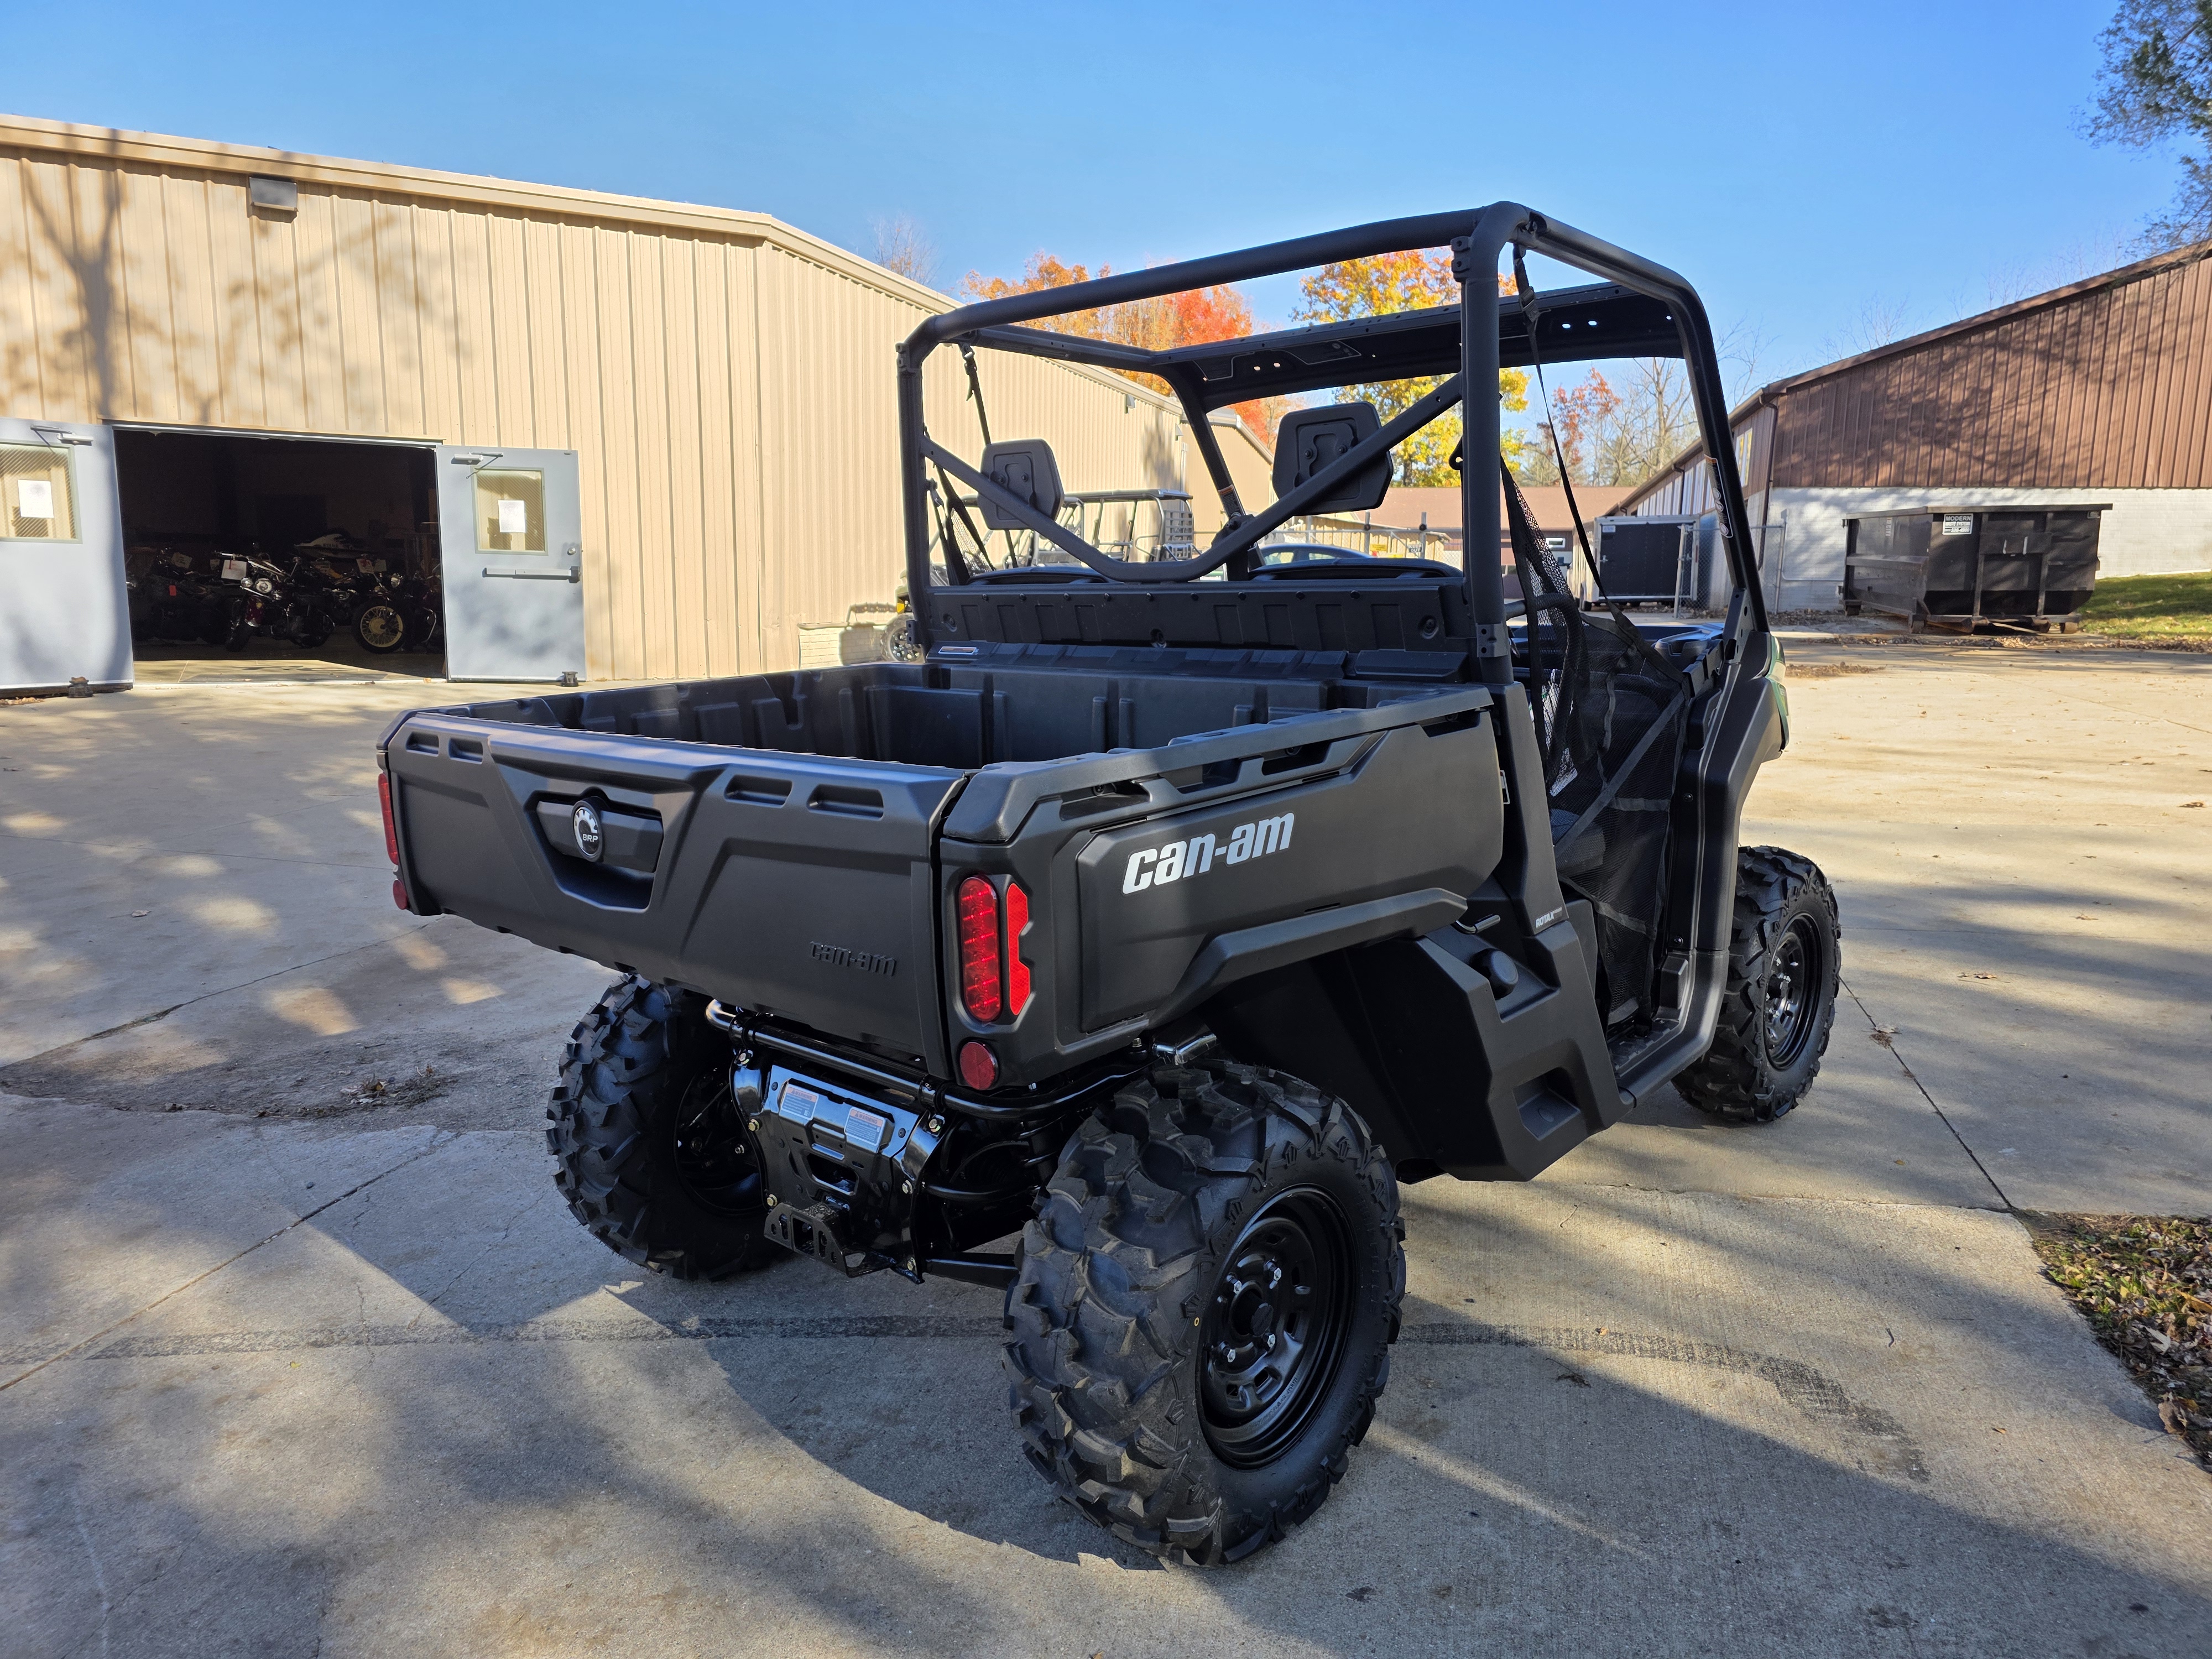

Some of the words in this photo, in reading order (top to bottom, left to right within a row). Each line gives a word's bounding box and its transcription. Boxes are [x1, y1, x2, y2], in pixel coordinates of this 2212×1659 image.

[582, 833, 598, 843] BRP
[1536, 910, 1554, 928] ROTAX
[795, 1091, 813, 1100] WARNING
[859, 1113, 878, 1125] WARNING
